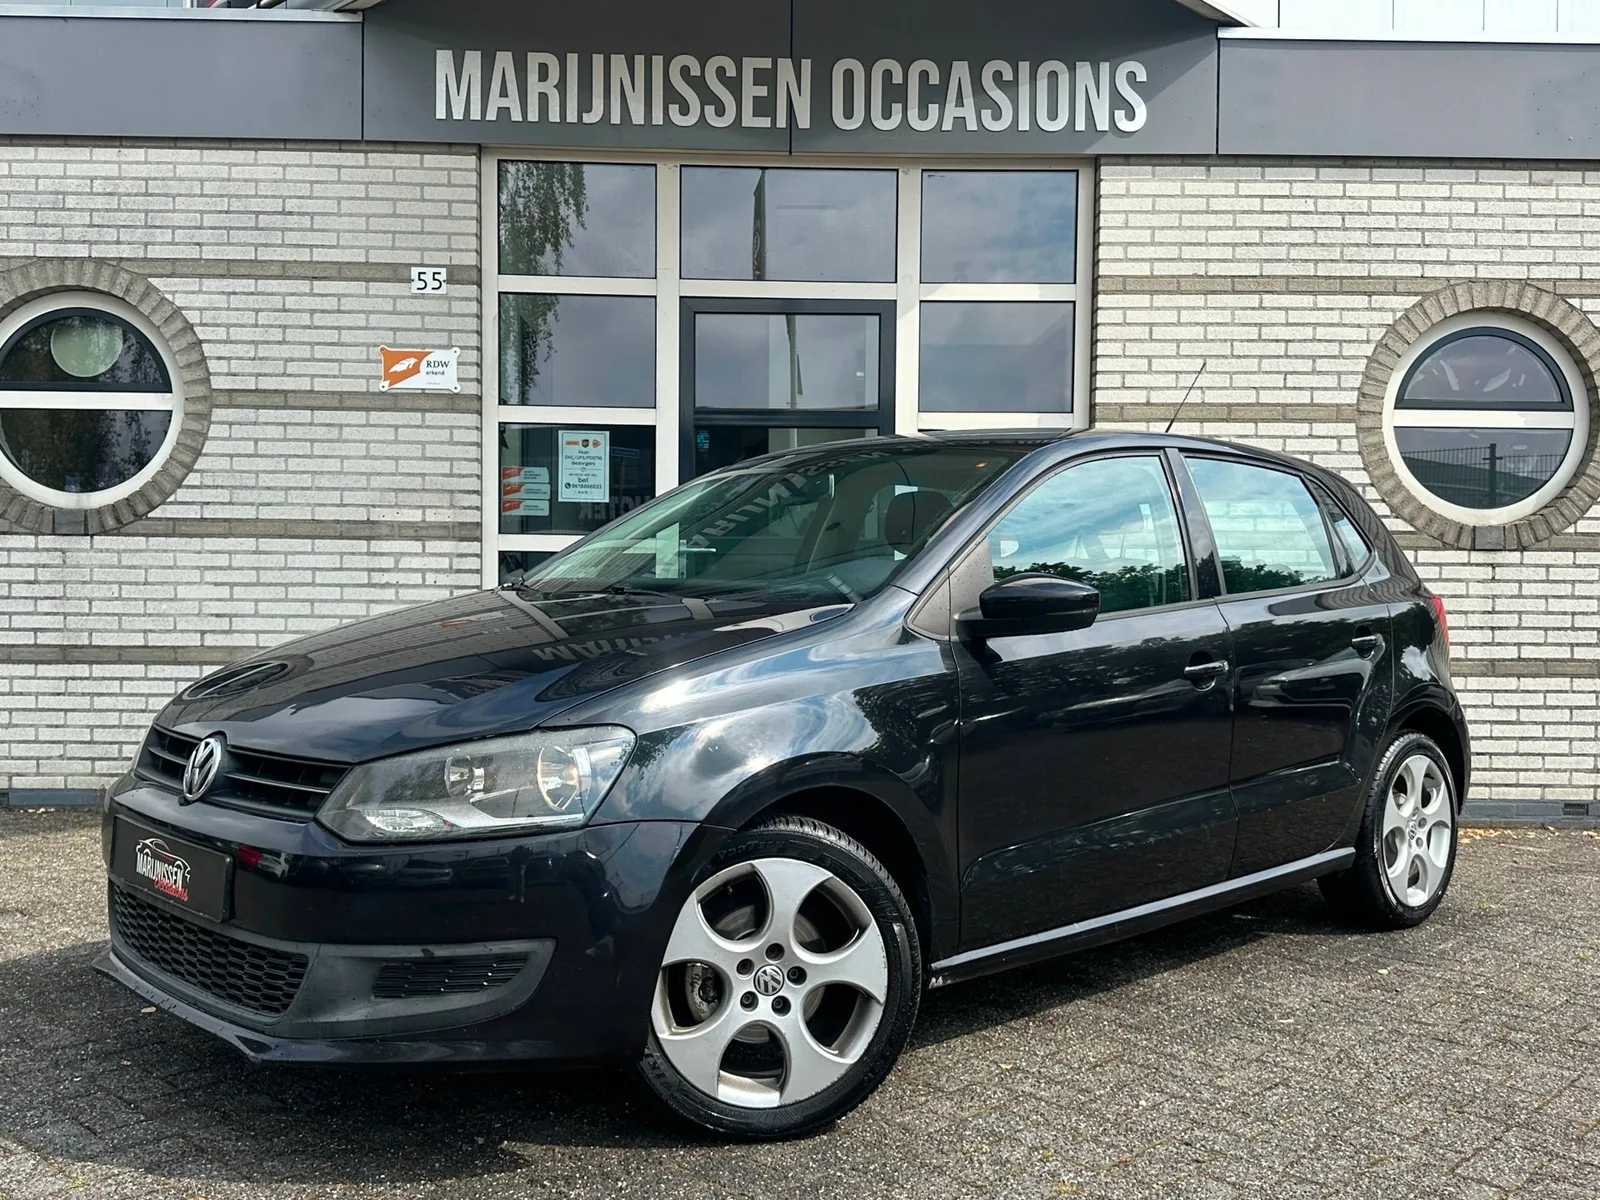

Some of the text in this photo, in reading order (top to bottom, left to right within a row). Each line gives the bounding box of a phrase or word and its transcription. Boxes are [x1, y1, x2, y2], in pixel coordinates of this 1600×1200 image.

[435, 49, 1148, 133] MARIJNISSEN OCCASIONS
[416, 271, 443, 291] 55
[426, 360, 450, 368] RDW
[135, 852, 184, 890] MARIJNISSEN
